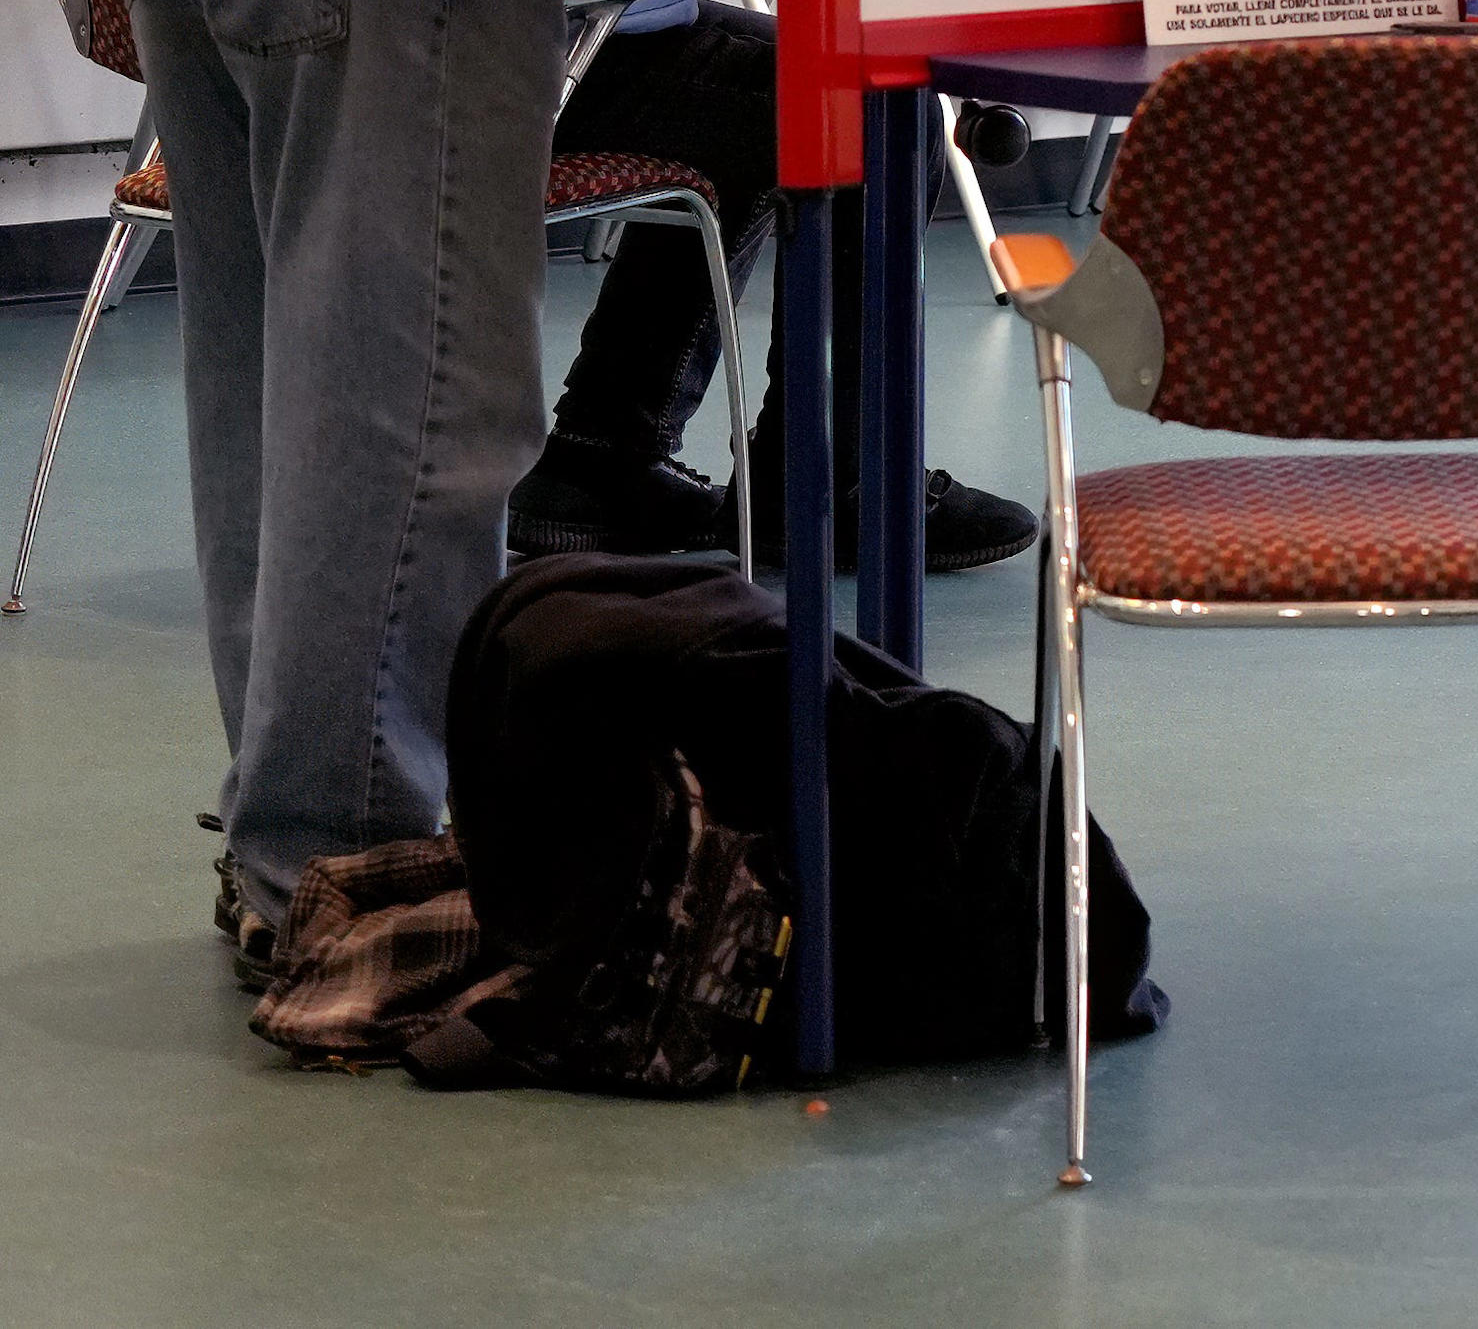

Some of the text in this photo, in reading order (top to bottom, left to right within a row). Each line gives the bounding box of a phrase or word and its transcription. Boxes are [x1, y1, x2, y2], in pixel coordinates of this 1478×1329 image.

[1175, 3, 1202, 15] PARA
[1245, 0, 1276, 11] LLENE
[1166, 20, 1186, 31] USE
[1190, 15, 1251, 29] SOLAMENTE
[1255, 14, 1266, 26] EL
[1323, 9, 1369, 22] ESPECIAL
[1373, 7, 1392, 19] QUE
[1396, 6, 1409, 17] SE
[1411, 5, 1424, 16] LE
